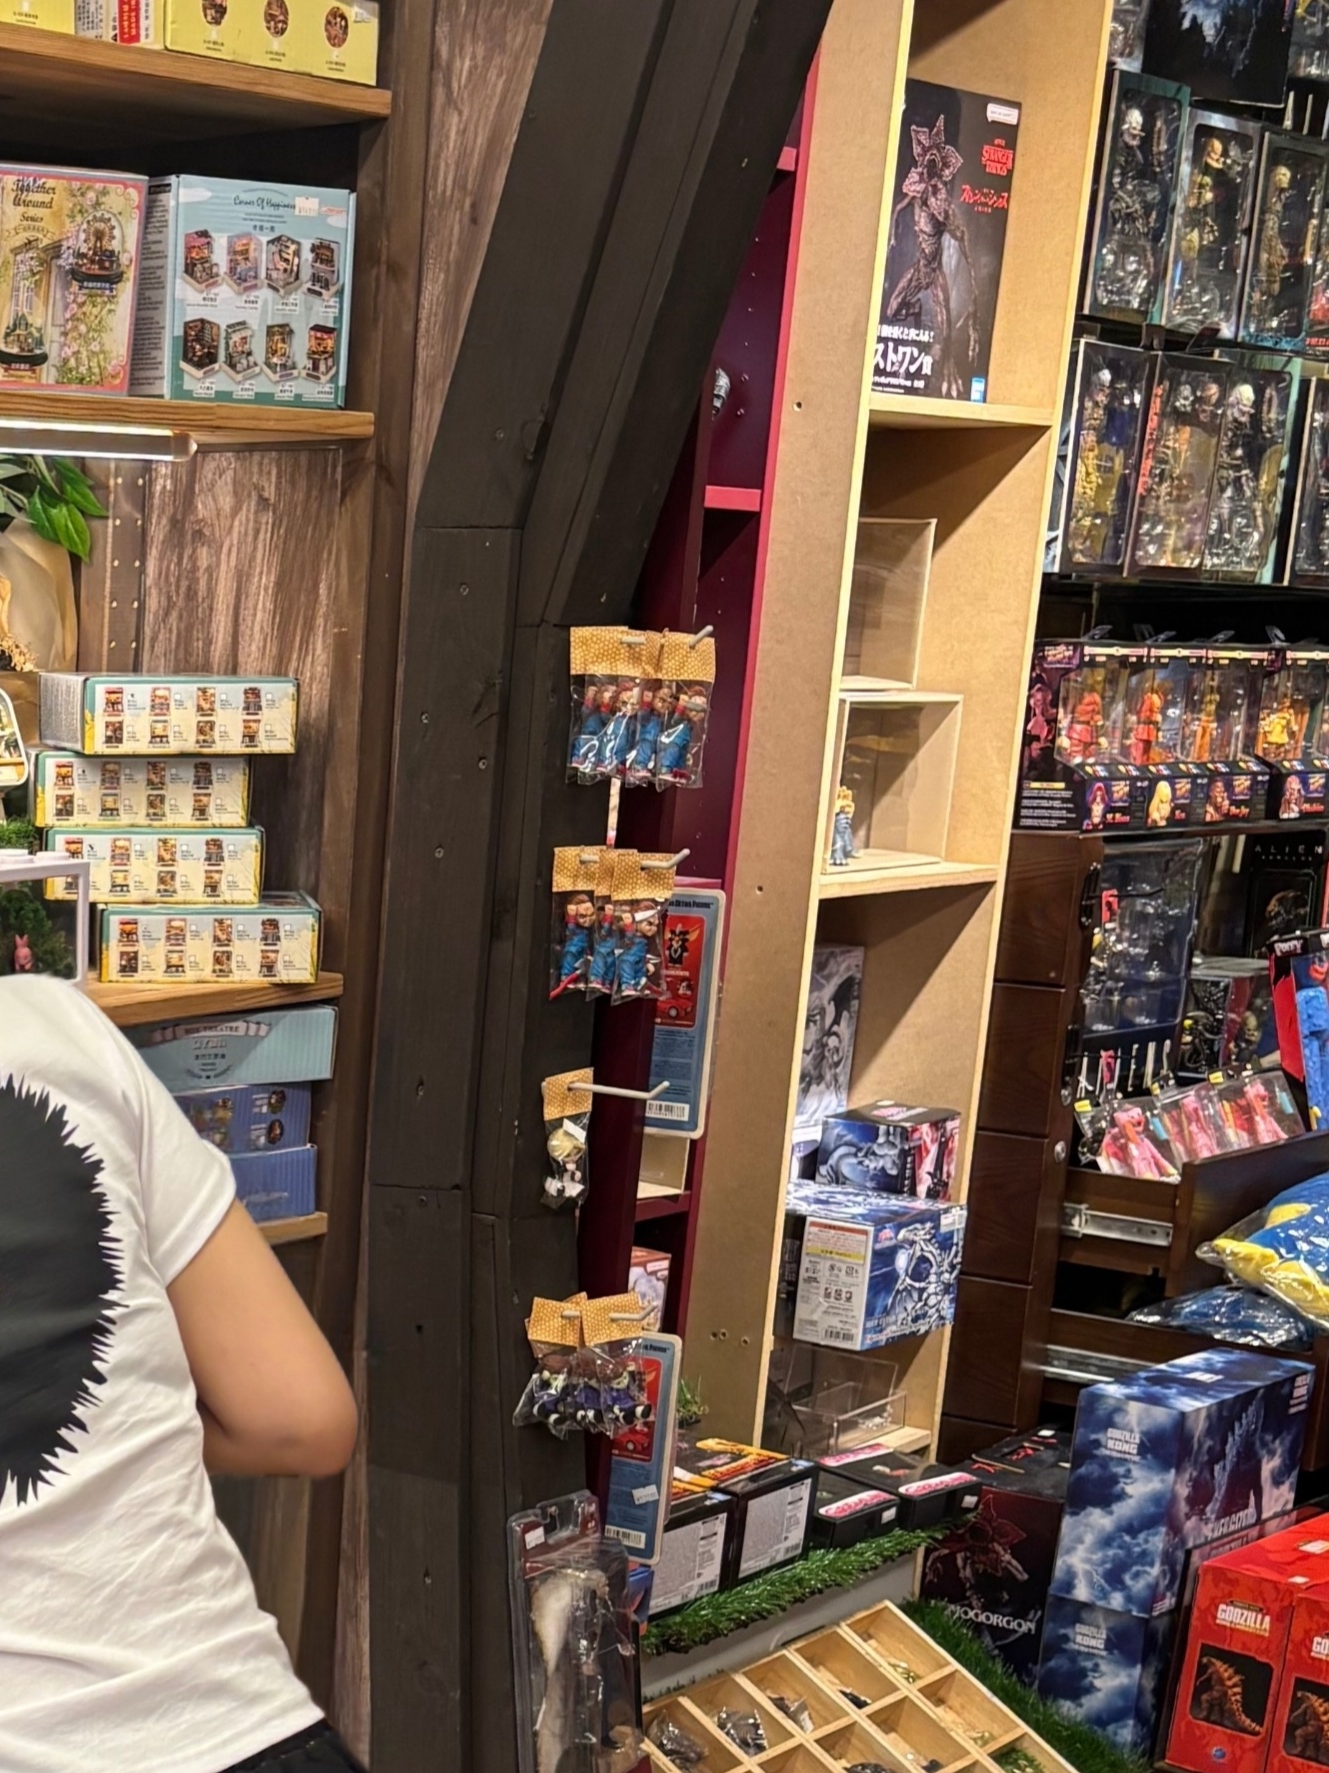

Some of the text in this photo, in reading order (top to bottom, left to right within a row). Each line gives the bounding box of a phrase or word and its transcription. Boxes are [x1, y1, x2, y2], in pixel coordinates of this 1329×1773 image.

[1107, 1428, 1140, 1443] GODZILLA
[1107, 1441, 1138, 1454] KONG
[1217, 1603, 1271, 1631] GODZILLA
[1075, 1635, 1105, 1650] KONG
